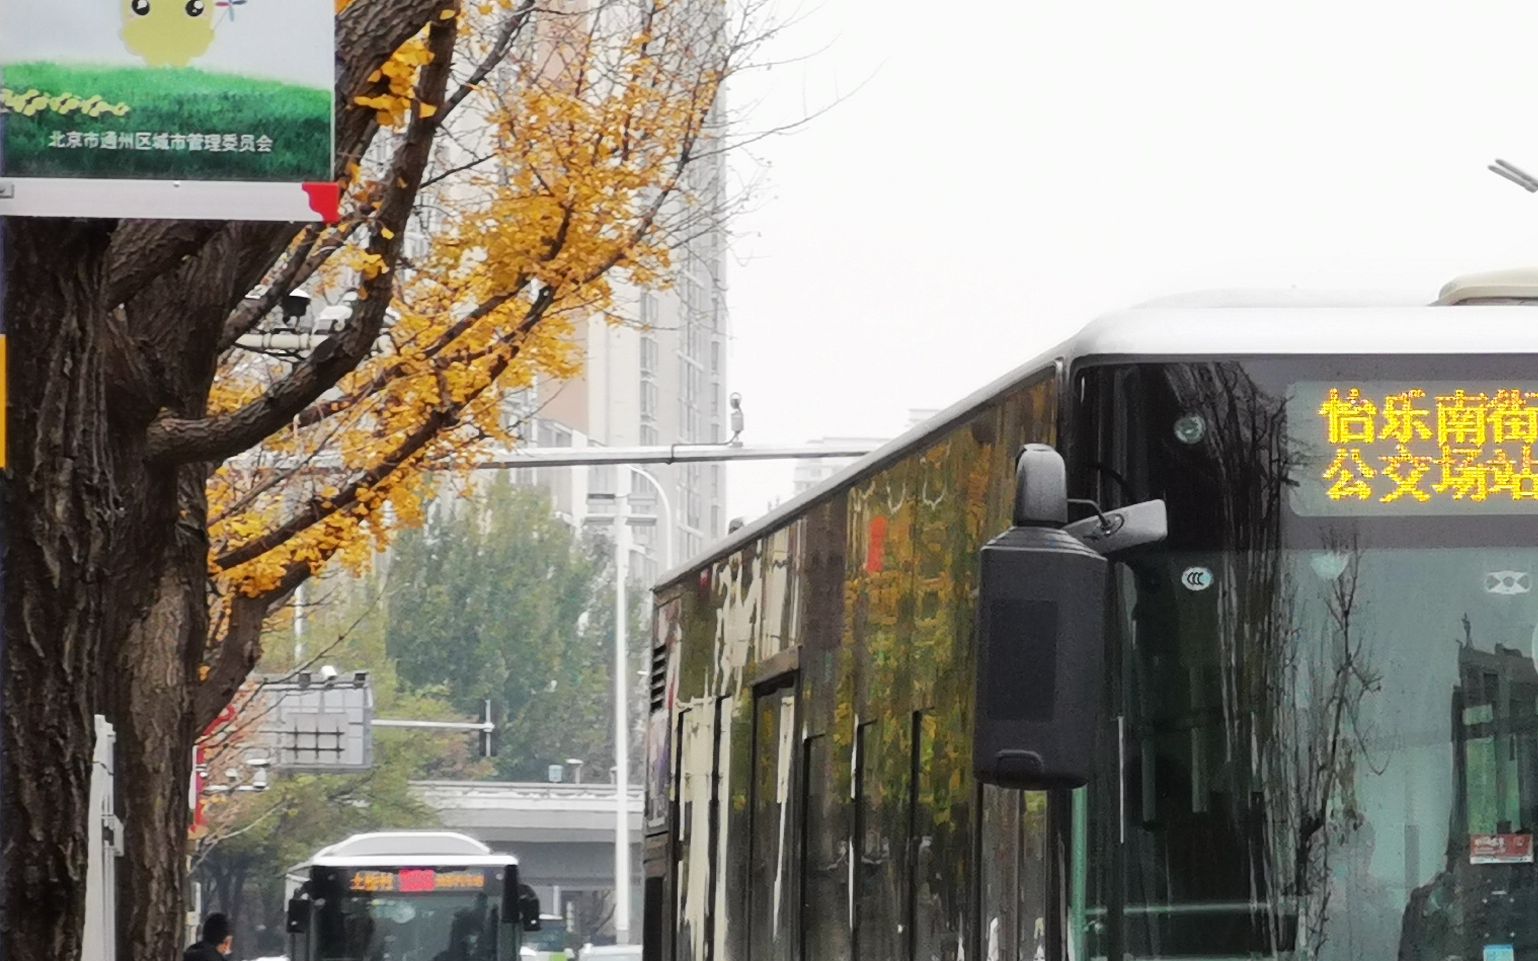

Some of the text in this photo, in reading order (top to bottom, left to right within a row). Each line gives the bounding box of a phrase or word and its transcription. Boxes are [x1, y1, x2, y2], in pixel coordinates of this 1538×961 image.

[48, 131, 274, 152] 北京市通州区城市管理委员会
